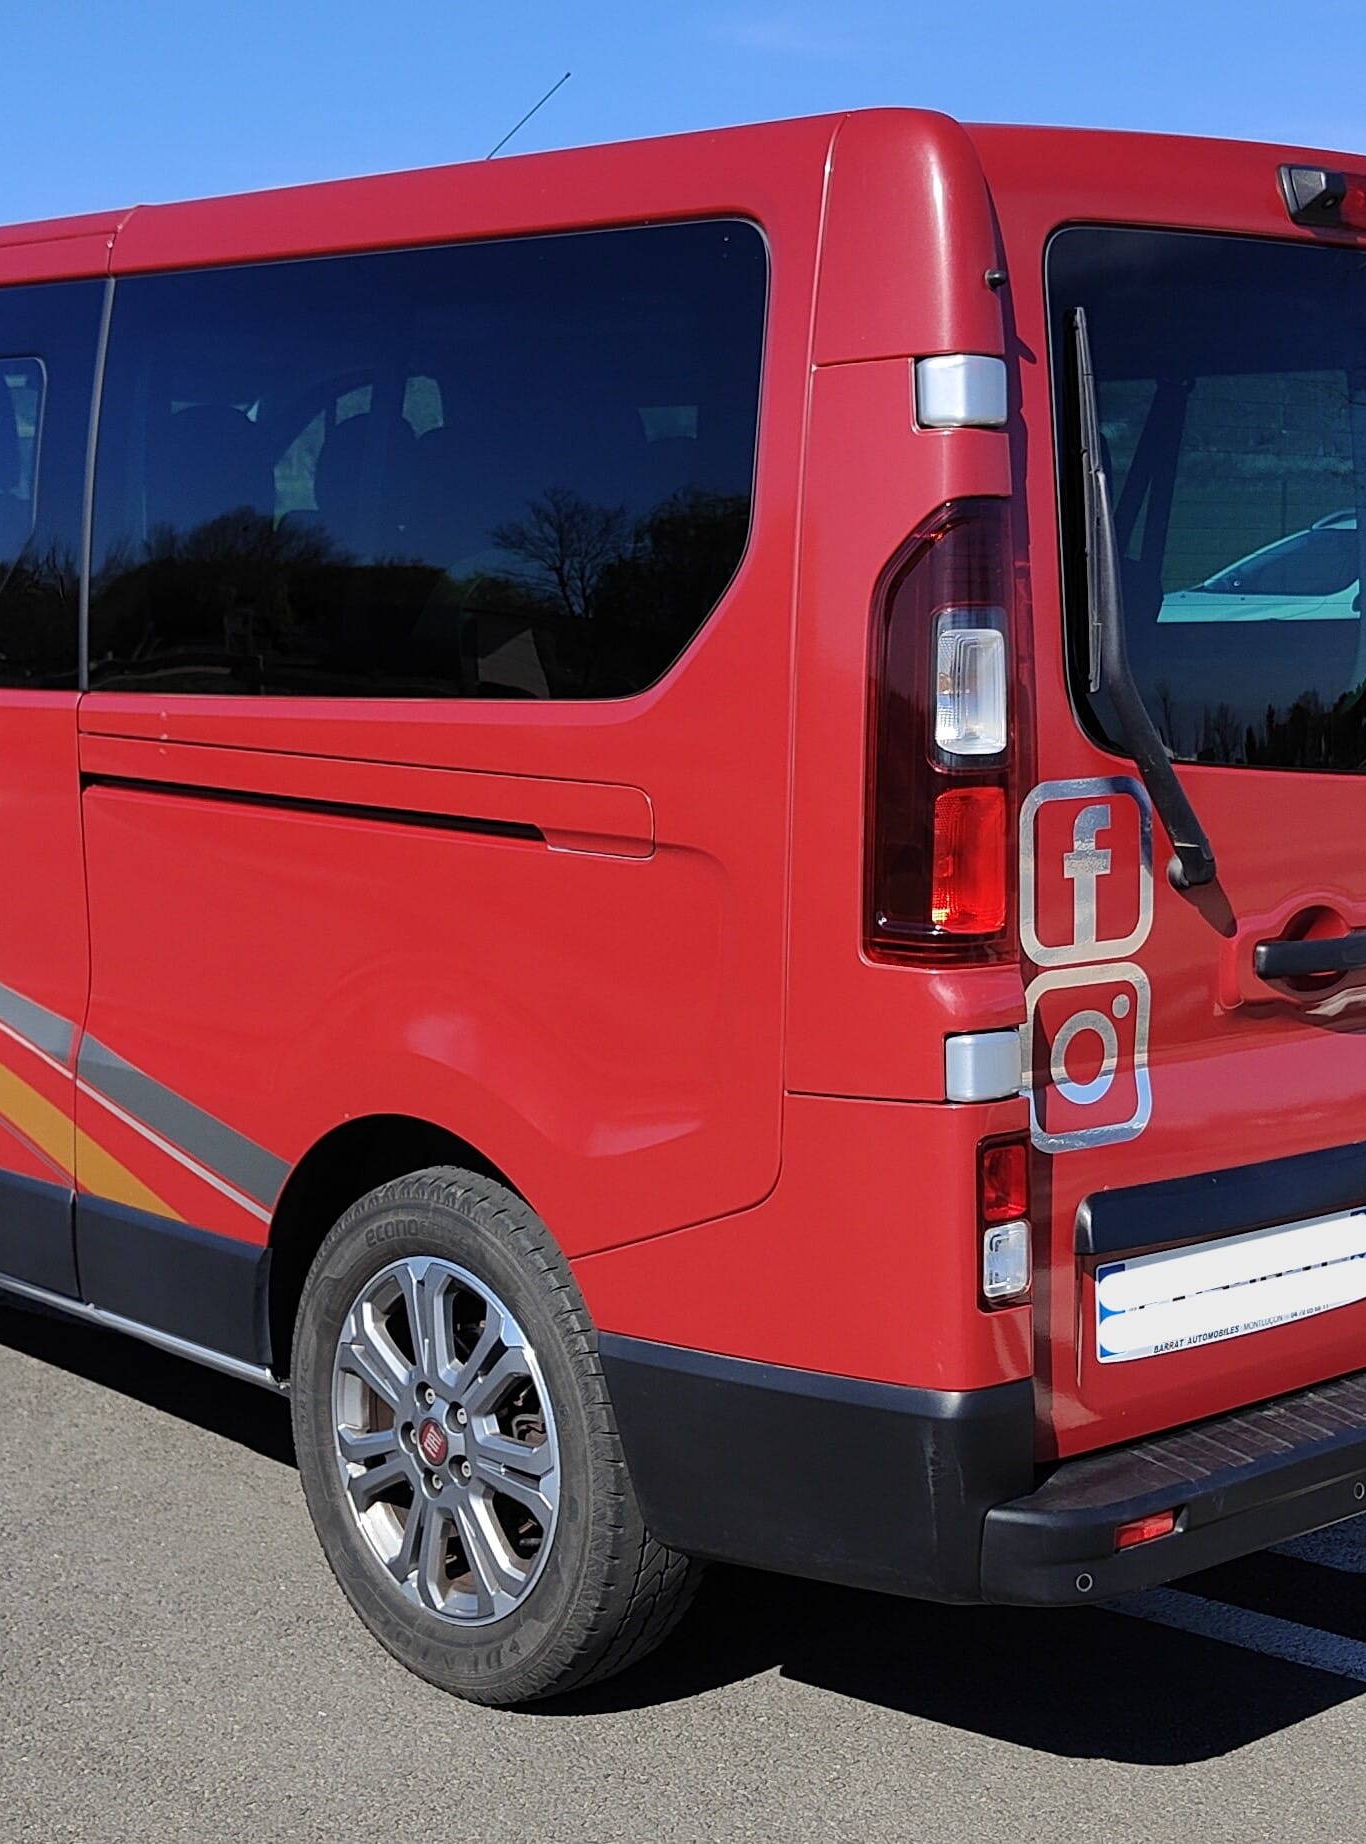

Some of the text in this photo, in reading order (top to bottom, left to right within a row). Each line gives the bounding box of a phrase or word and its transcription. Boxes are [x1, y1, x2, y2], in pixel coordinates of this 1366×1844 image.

[1153, 1339, 1184, 1354] BARRAT
[1186, 1325, 1240, 1345] AUTOMOBILES
[423, 1425, 442, 1458] FIAT
